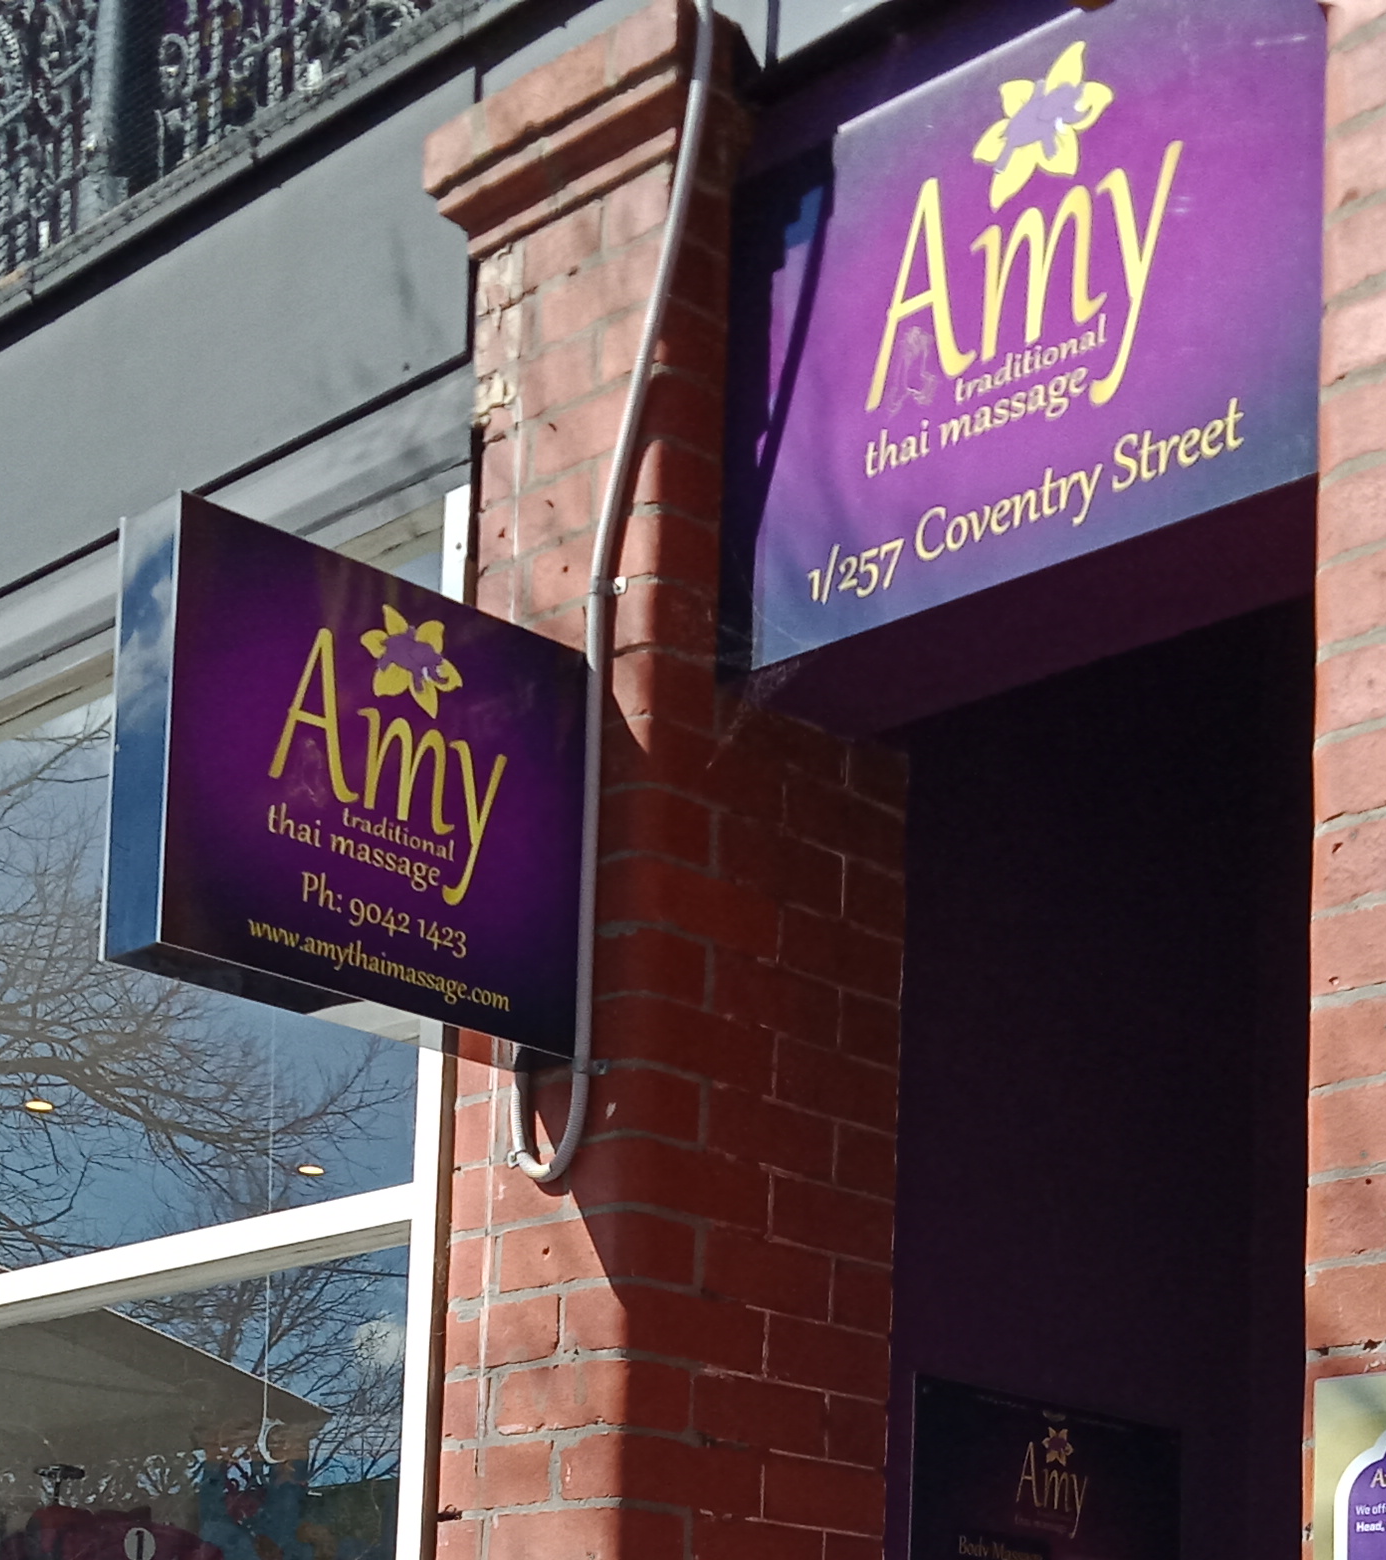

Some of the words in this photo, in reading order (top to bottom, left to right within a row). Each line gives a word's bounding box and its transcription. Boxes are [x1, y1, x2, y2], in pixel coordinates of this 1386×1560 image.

[864, 140, 1184, 411] Amy
[954, 314, 1106, 402] traditional
[866, 420, 930, 478] thai
[940, 366, 1089, 444] massage
[808, 538, 905, 604] 1/257
[914, 463, 1103, 561] Coventry
[1112, 398, 1245, 491] Street
[268, 627, 507, 906] Amy
[268, 803, 321, 848] thai
[331, 832, 440, 891] massage
[343, 808, 455, 861] traditional
[301, 871, 342, 914] Ph:
[349, 898, 411, 937] 9042
[417, 919, 467, 958] 1423
[248, 917, 510, 1012] www.amythaimassage.com
[1016, 1441, 1089, 1539] Amy
[1355, 1505, 1371, 1515] We
[1356, 1522, 1385, 1533] Head,
[135, 1530, 144, 1560] 1
